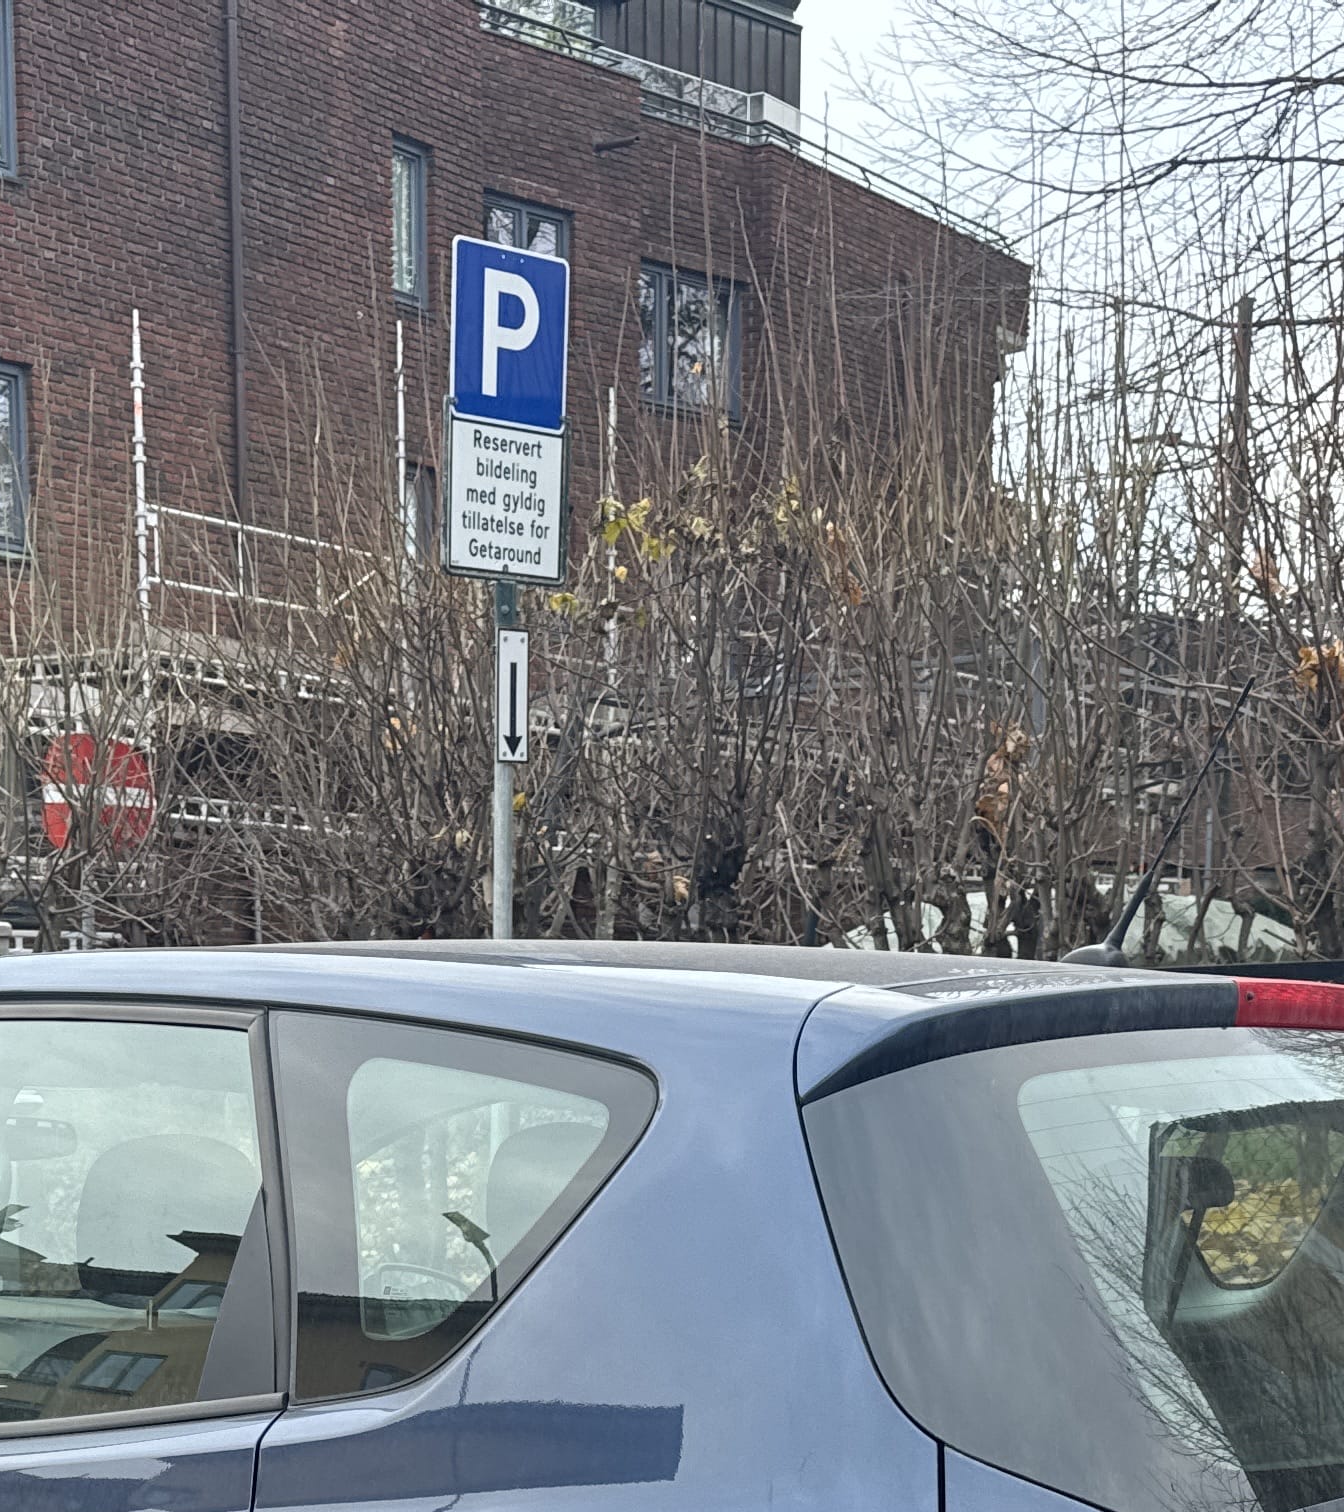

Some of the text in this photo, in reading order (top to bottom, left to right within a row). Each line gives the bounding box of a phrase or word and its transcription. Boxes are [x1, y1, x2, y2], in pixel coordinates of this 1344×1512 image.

[481, 267, 540, 397] P
[473, 429, 543, 459] Reservert
[476, 457, 537, 489] bildeling
[466, 487, 546, 517] med gyldig
[462, 510, 550, 540] tillatelse for
[468, 538, 541, 565] Getaround
